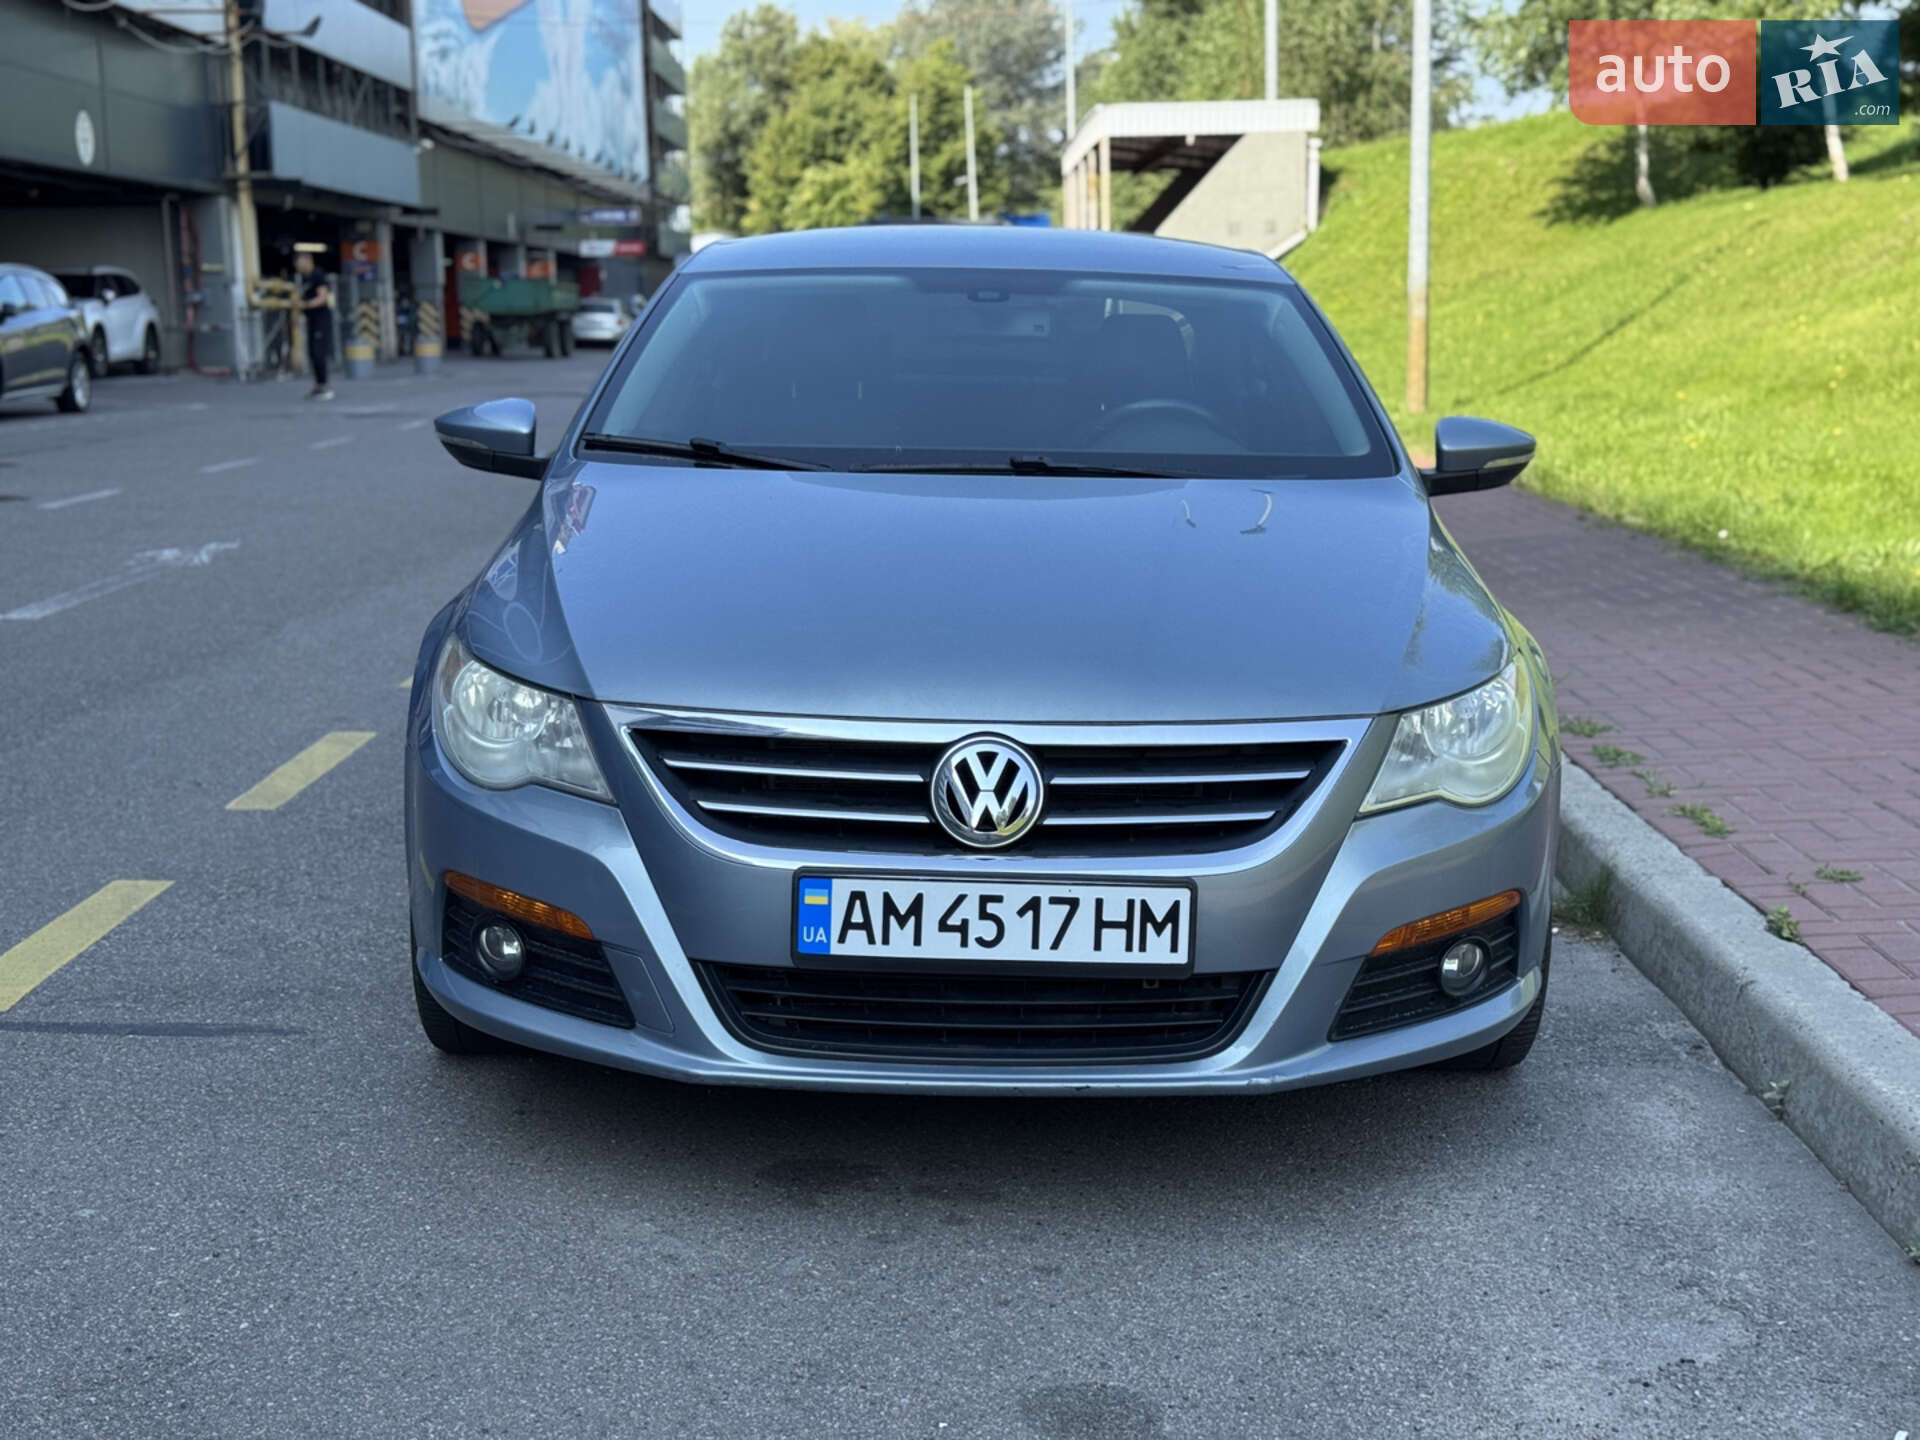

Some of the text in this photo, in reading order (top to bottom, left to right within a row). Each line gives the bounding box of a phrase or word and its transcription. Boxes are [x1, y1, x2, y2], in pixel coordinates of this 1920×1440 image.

[802, 926, 828, 944] UA
[836, 890, 1182, 954] AM 4517 HM
